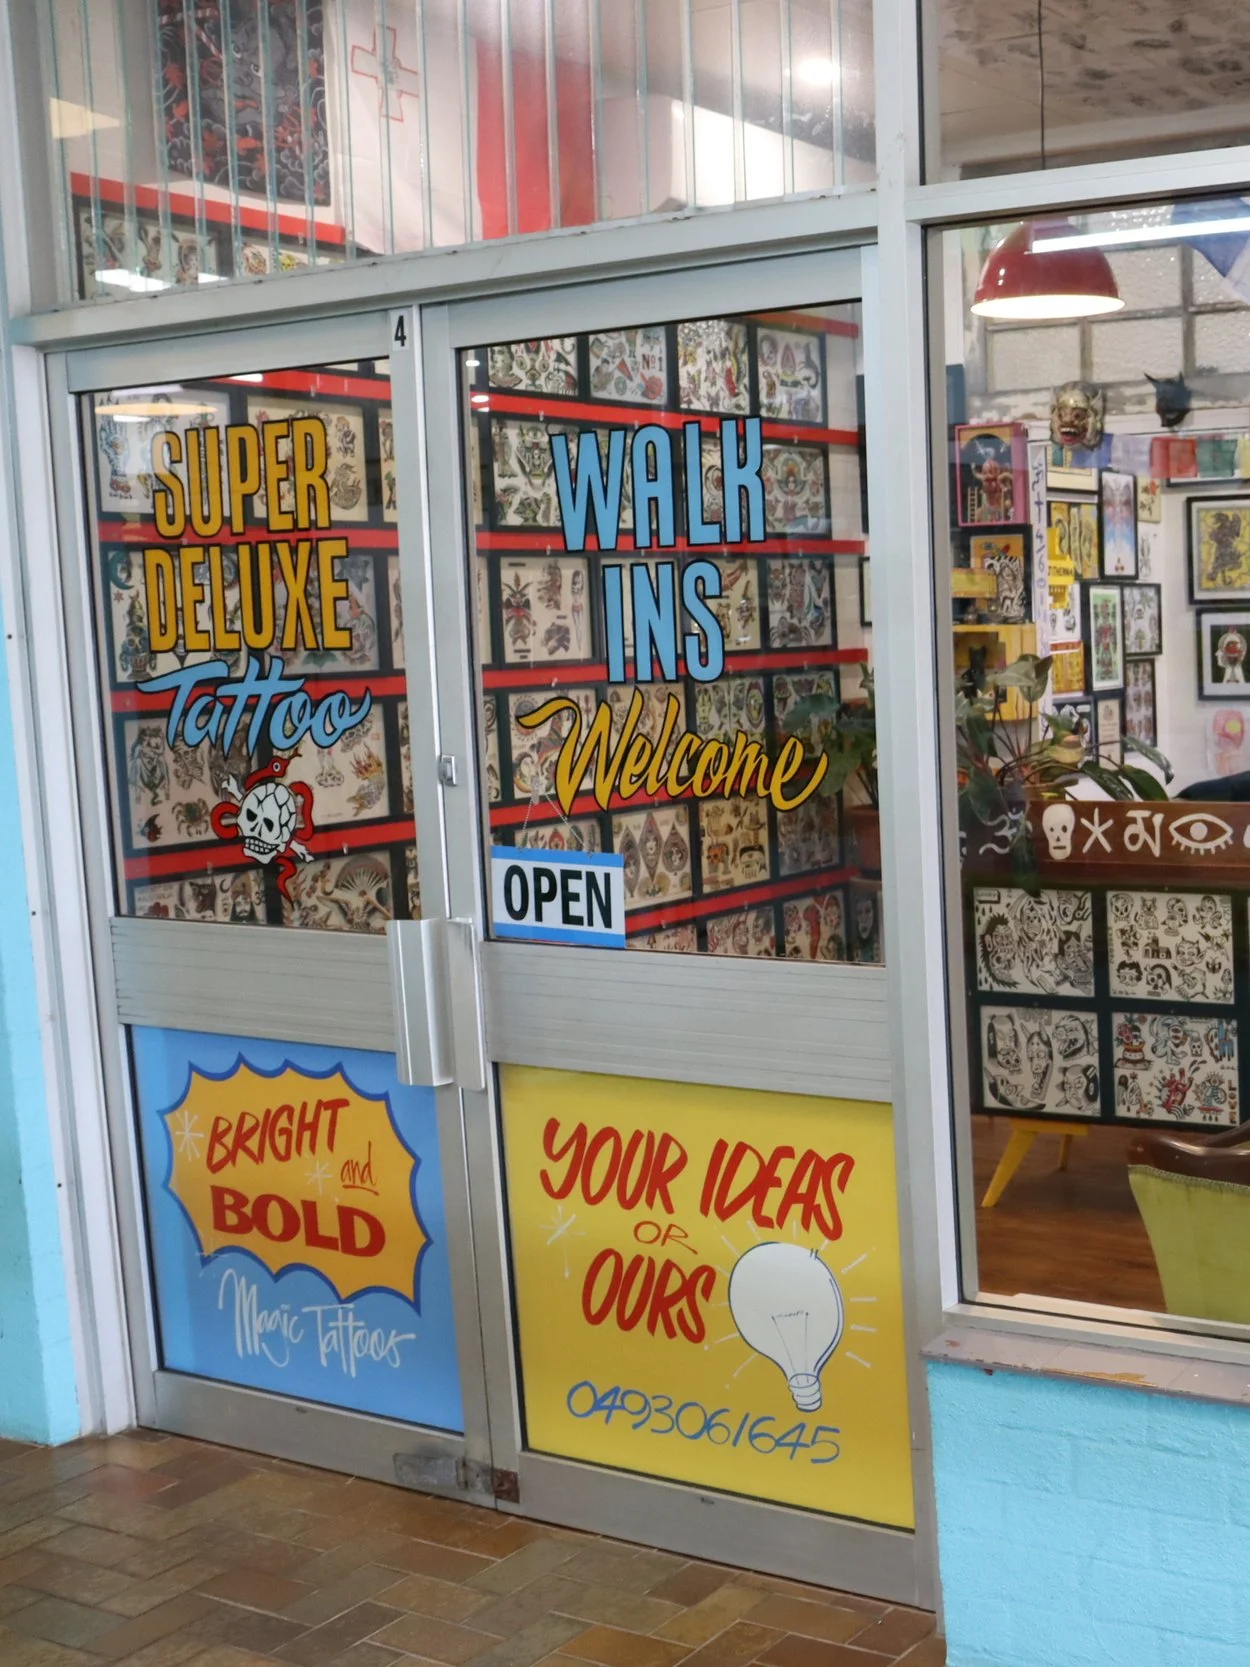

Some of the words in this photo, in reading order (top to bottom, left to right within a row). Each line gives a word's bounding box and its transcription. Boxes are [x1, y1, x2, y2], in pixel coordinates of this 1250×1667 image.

[393, 315, 406, 347] 4
[151, 415, 332, 540] SUPER
[549, 417, 767, 552] WALK
[143, 536, 353, 653] DELUXE
[602, 559, 727, 684] INS
[136, 656, 372, 760] Tattoo
[515, 686, 829, 816] Welcome
[503, 865, 614, 931] OPEN
[206, 1099, 350, 1174] BRIGHT
[340, 1141, 378, 1188] and
[540, 1117, 688, 1214] YOUR
[699, 1138, 855, 1241] IDEAS
[210, 1184, 387, 1258] BOLD
[633, 1220, 698, 1255] OR
[218, 1268, 305, 1368] Magic
[301, 1303, 416, 1379] Tattoos
[582, 1247, 717, 1344] OURS
[566, 1380, 840, 1464] 0493061645
